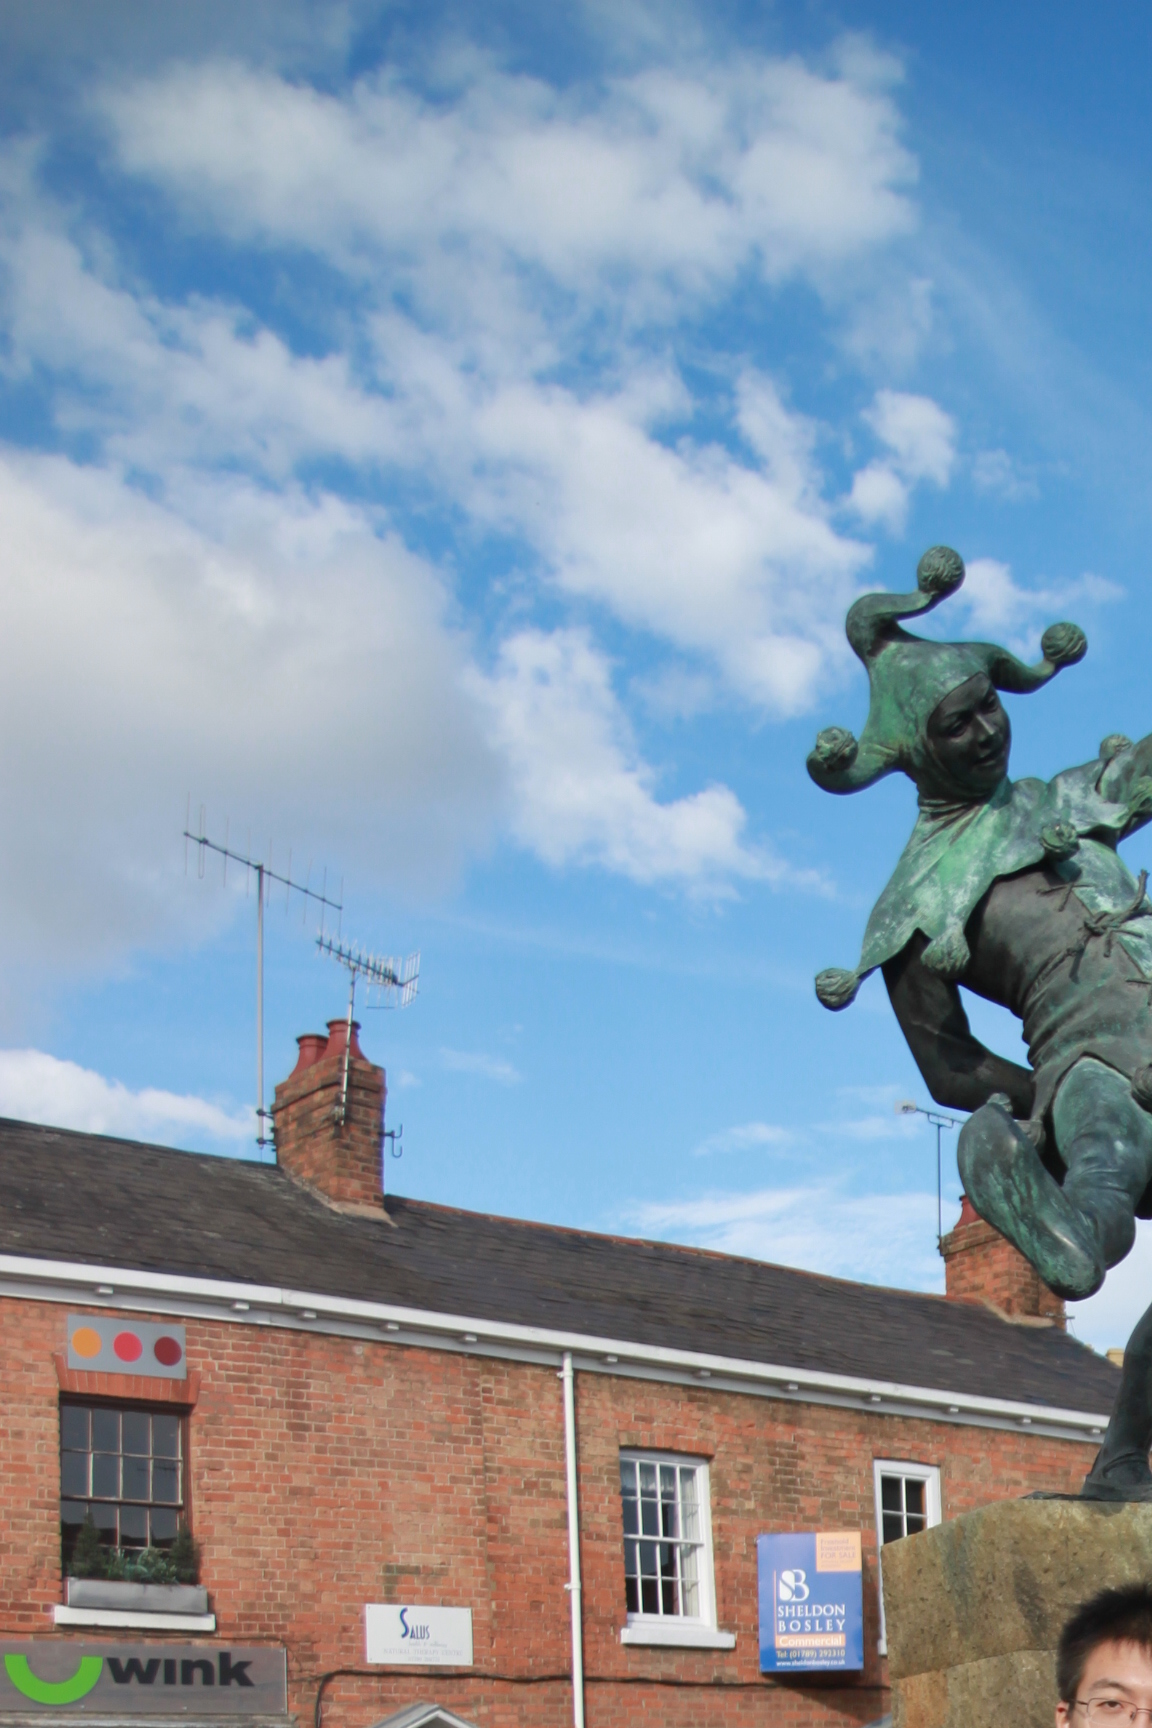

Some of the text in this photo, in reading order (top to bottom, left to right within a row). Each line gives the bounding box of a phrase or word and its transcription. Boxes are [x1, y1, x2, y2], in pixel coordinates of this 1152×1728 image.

[777, 1604, 846, 1618] SHELDON
[778, 1618, 846, 1633] BOSLEY
[779, 1635, 842, 1648] Commercial
[106, 1651, 256, 1687] wink
